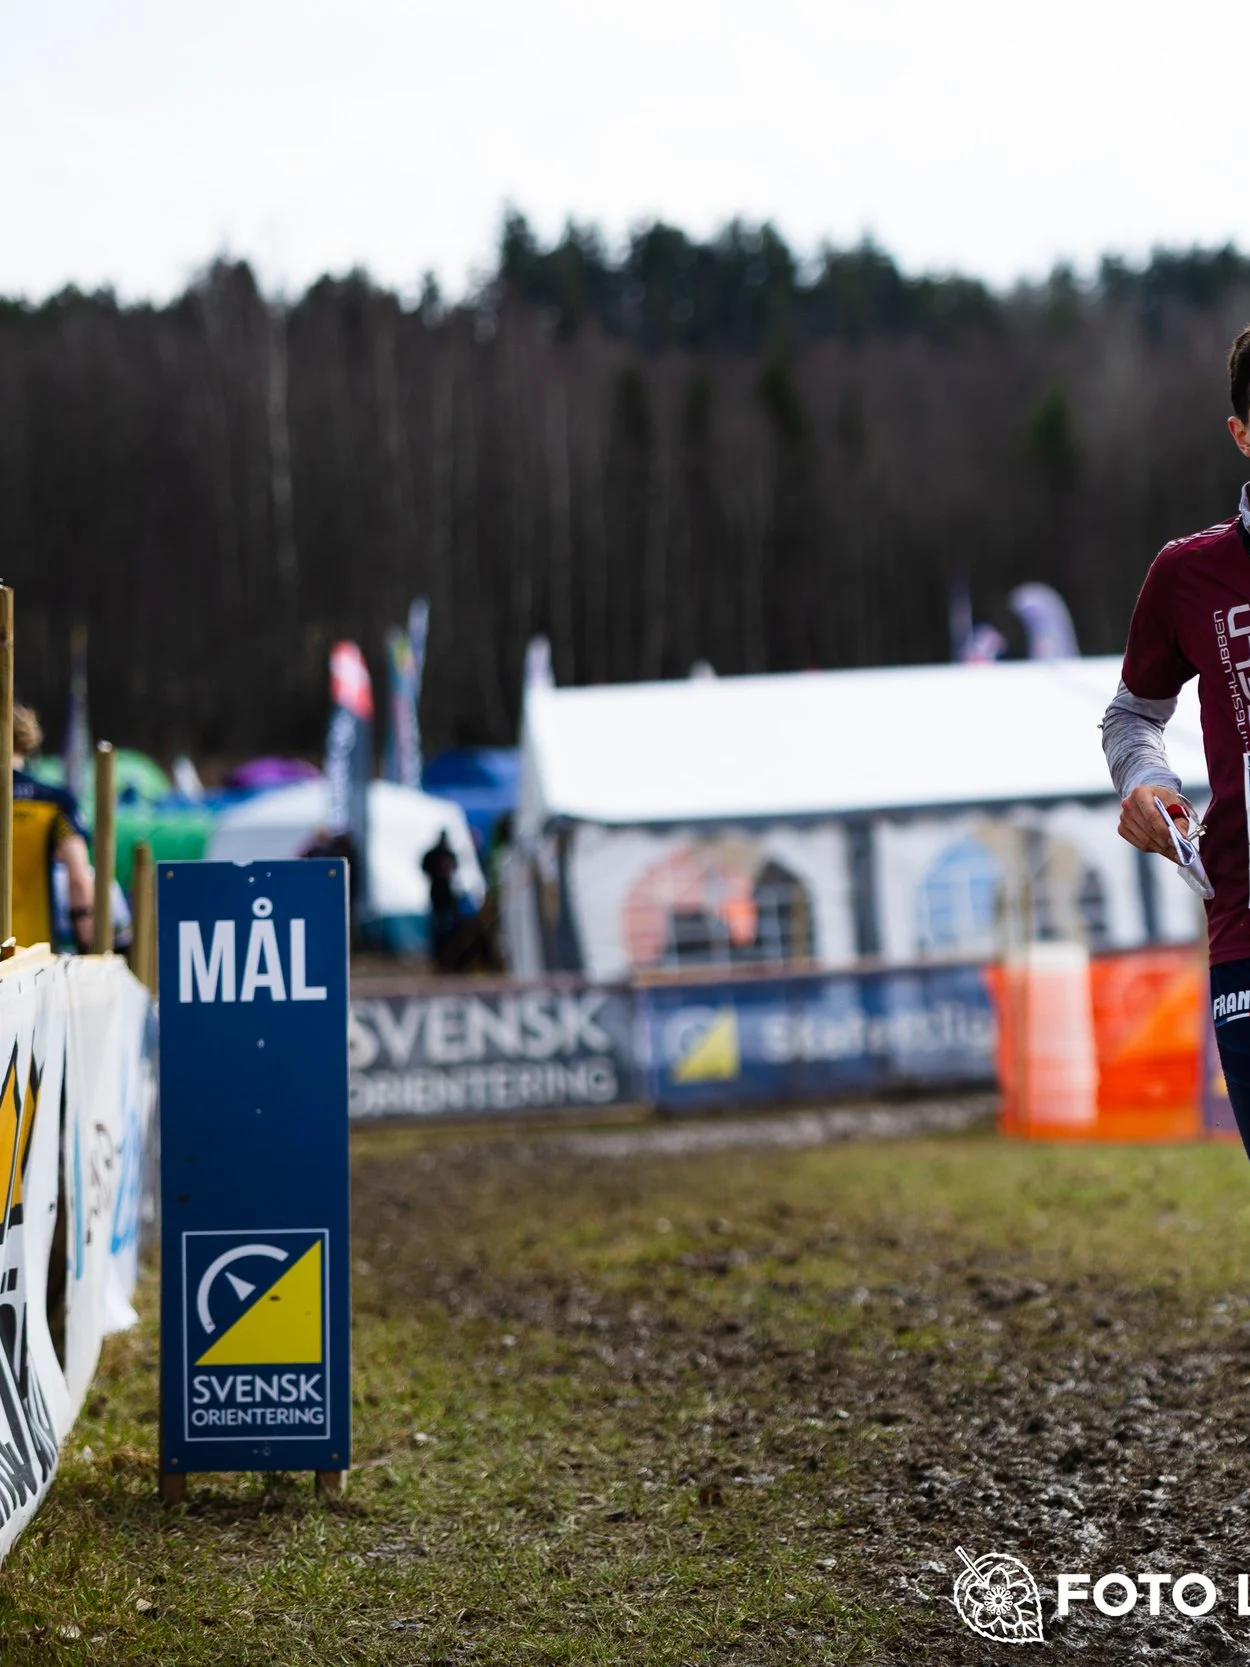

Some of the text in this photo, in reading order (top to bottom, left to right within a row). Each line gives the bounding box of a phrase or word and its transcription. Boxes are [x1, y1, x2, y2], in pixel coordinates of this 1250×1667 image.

[1213, 610, 1250, 753] INGSKLUBBEN
[178, 896, 328, 1003] MÅL
[191, 1406, 325, 1427] ORIENTERING
[192, 1373, 324, 1405] SVENSK
